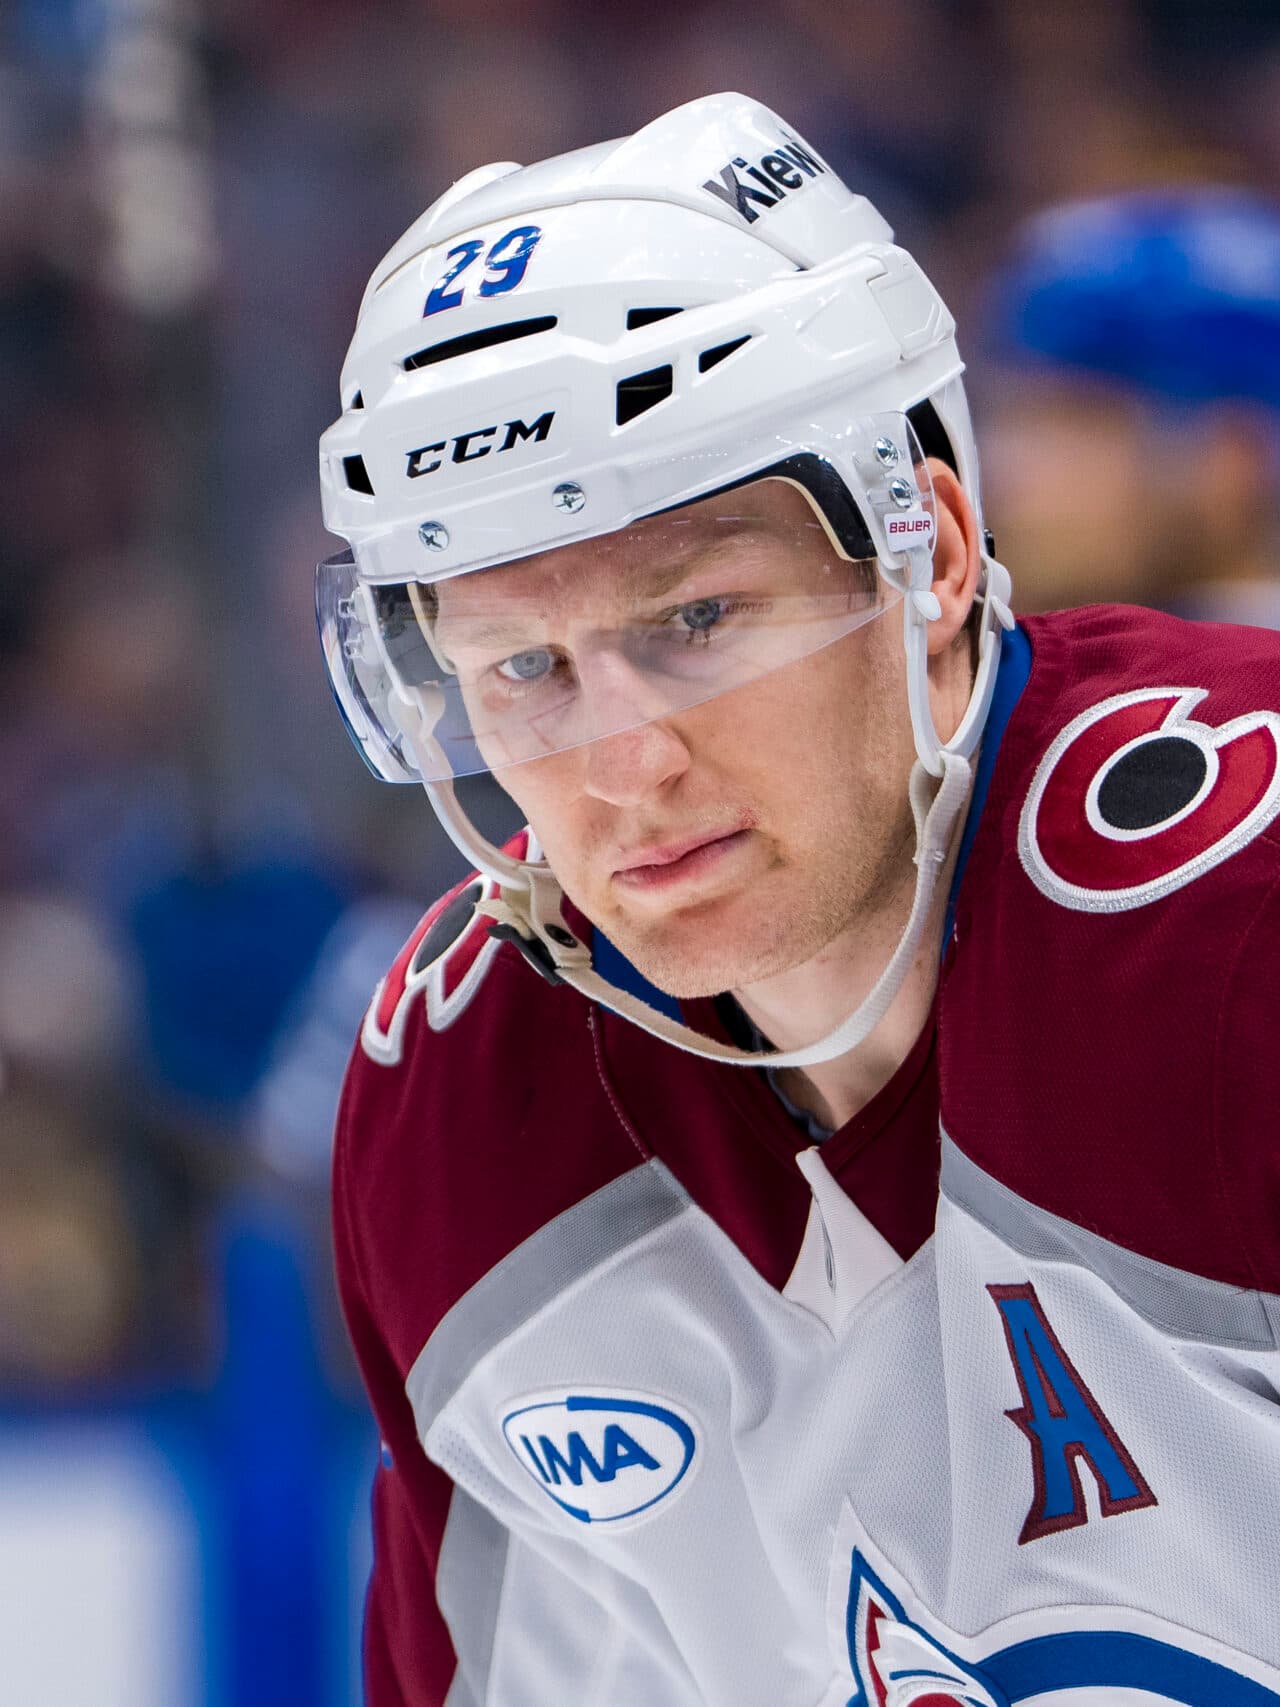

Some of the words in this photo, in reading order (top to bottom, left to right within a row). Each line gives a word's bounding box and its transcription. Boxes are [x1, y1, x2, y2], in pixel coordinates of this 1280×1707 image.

[702, 130, 832, 224] Kiew
[423, 226, 542, 318] 29
[405, 411, 556, 479] CCM
[520, 1424, 661, 1486] IMA
[985, 1281, 1159, 1546] A
